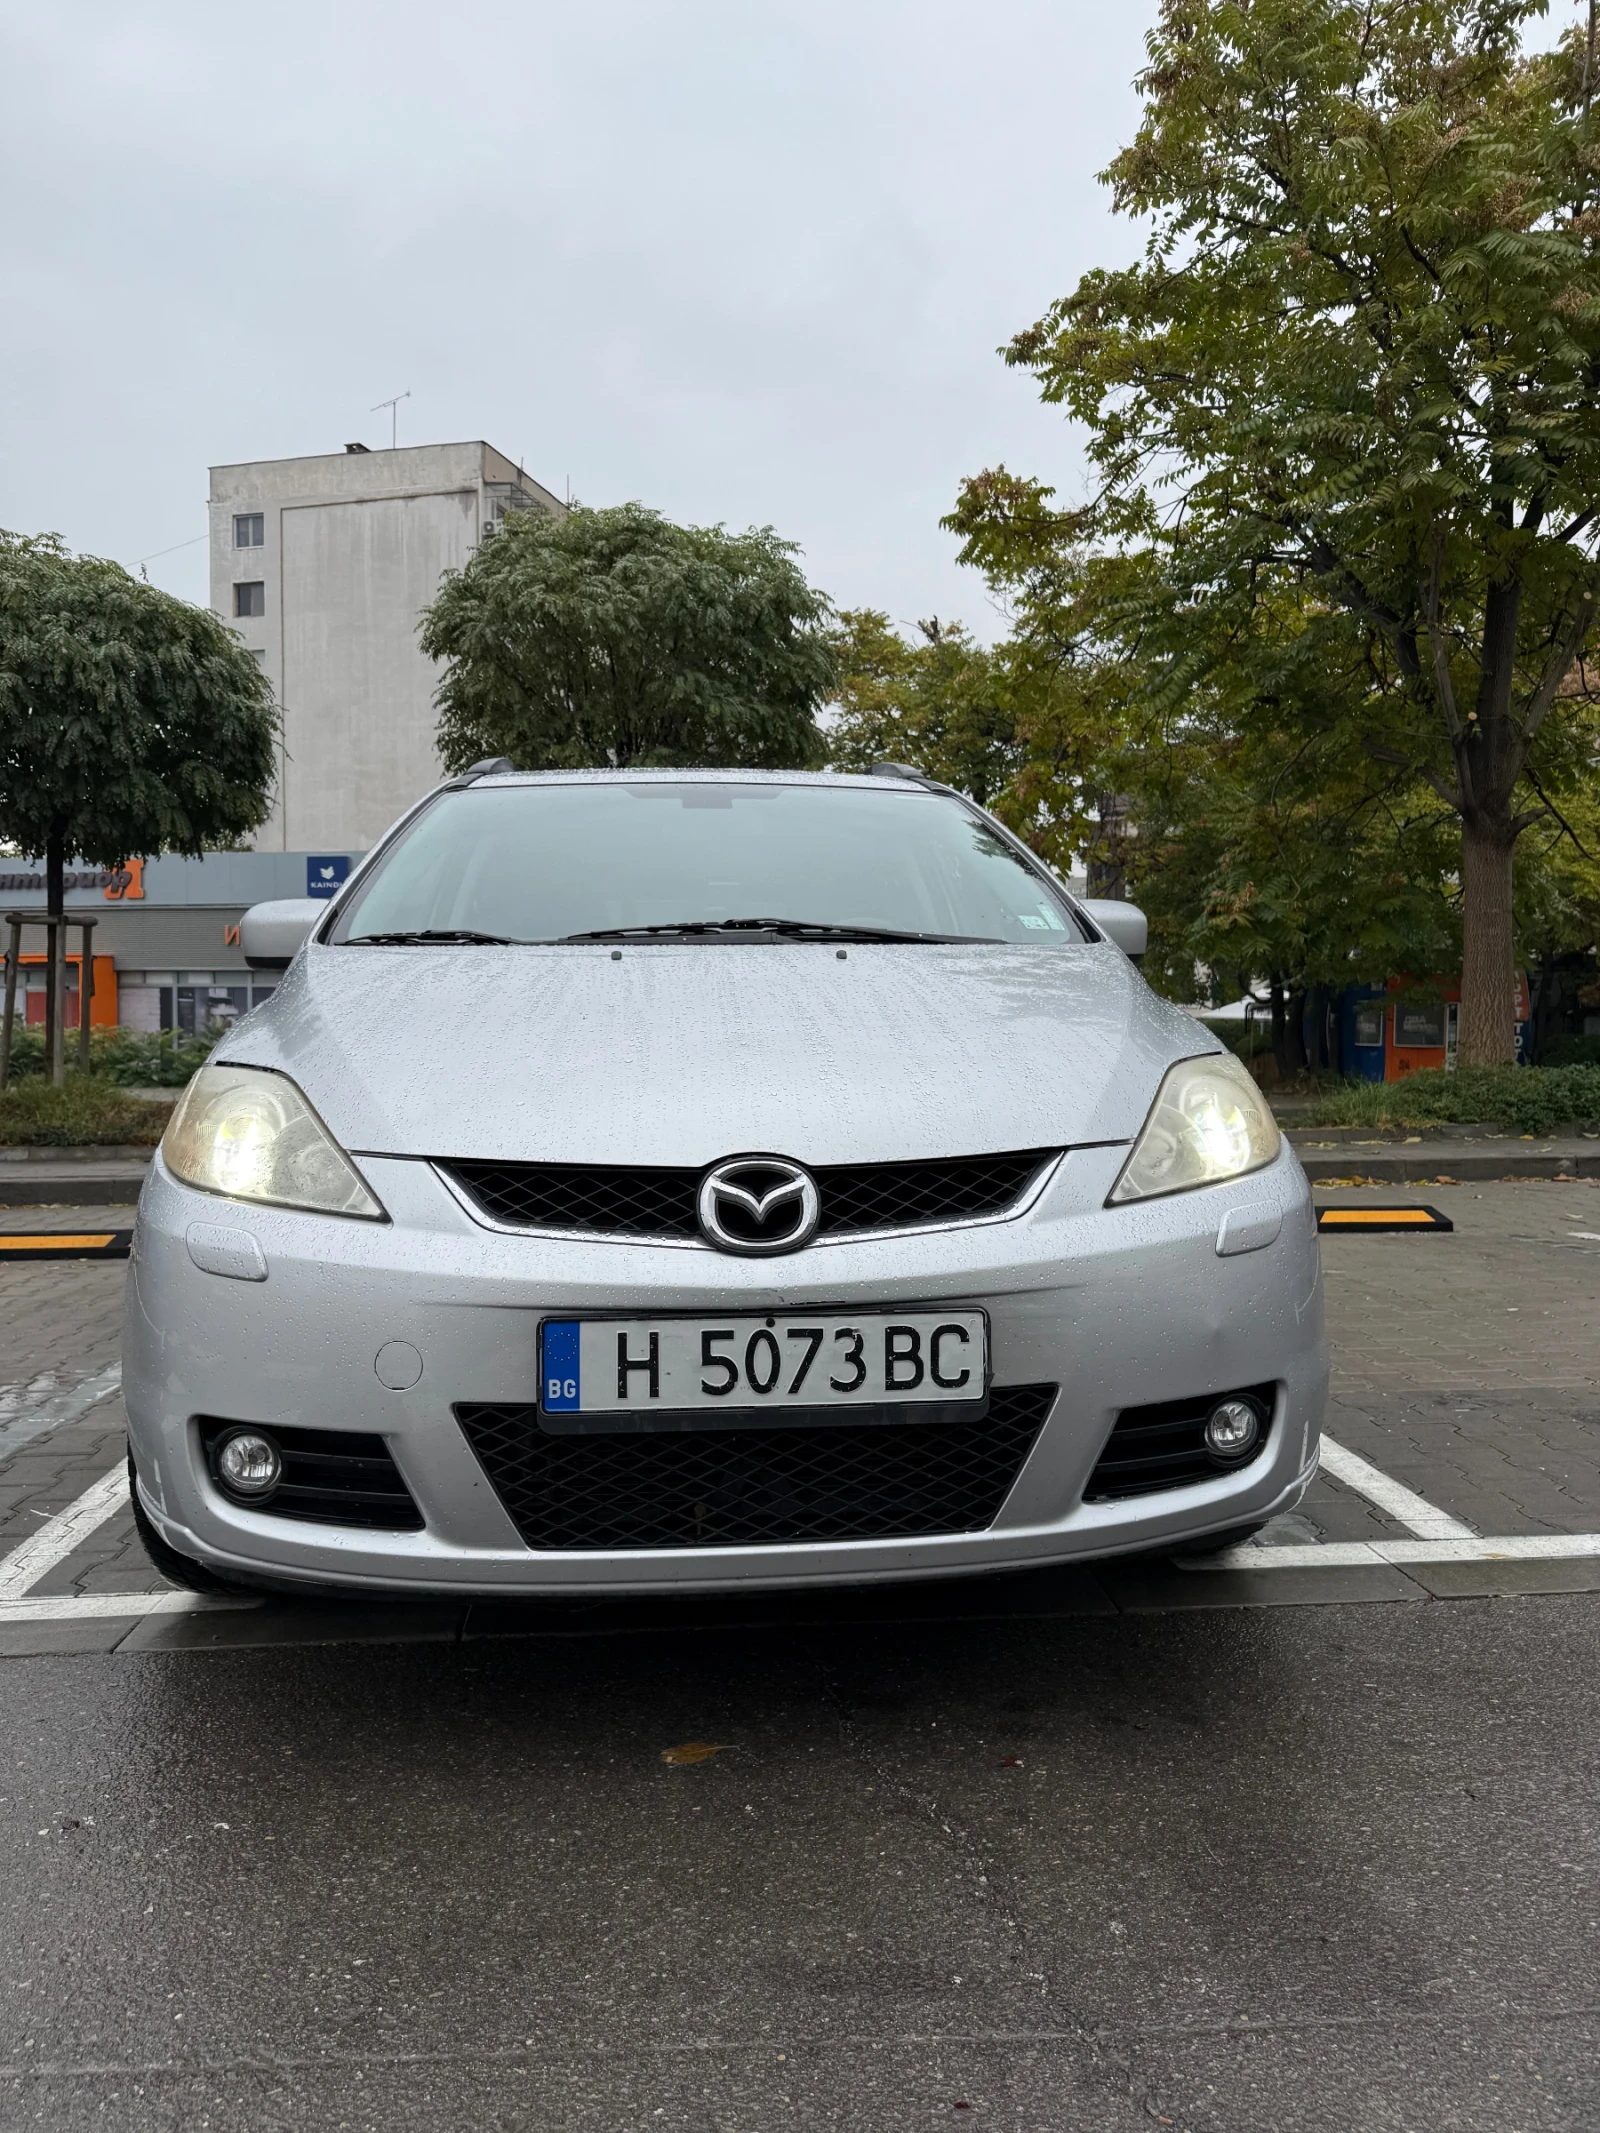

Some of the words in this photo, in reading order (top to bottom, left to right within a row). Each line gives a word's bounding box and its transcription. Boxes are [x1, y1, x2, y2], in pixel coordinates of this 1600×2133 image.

[0, 872, 132, 894] нтриор
[617, 1331, 660, 1399] H
[701, 1328, 867, 1396] 5073
[884, 1324, 971, 1391] BC
[548, 1379, 577, 1399] BG
